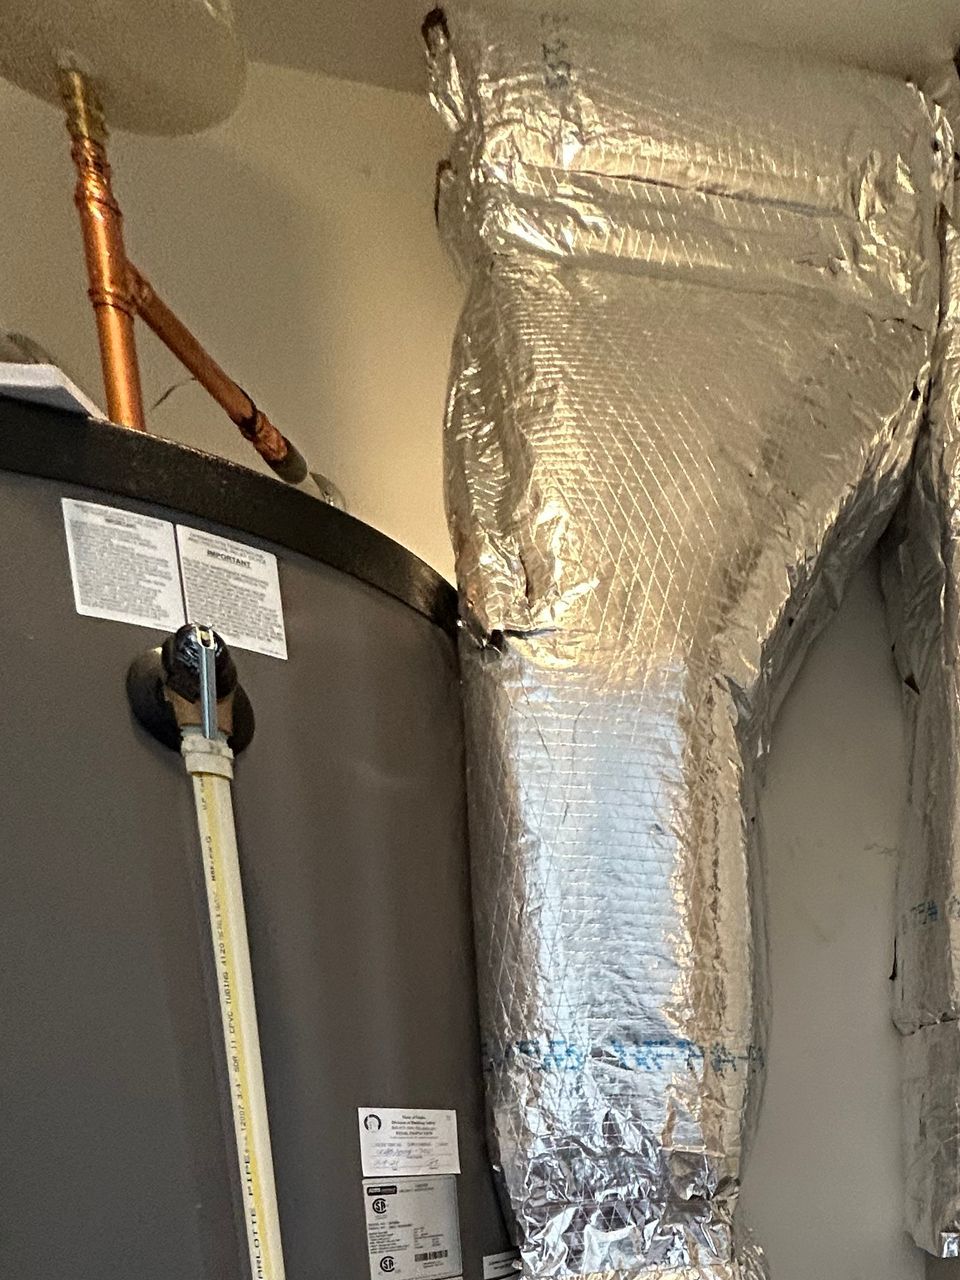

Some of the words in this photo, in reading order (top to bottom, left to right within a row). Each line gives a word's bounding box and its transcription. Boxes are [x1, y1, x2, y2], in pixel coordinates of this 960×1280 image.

[207, 549, 251, 568] IMPORTANT
[223, 972, 232, 1004] TUBING
[244, 1156, 254, 1196] PIPE
